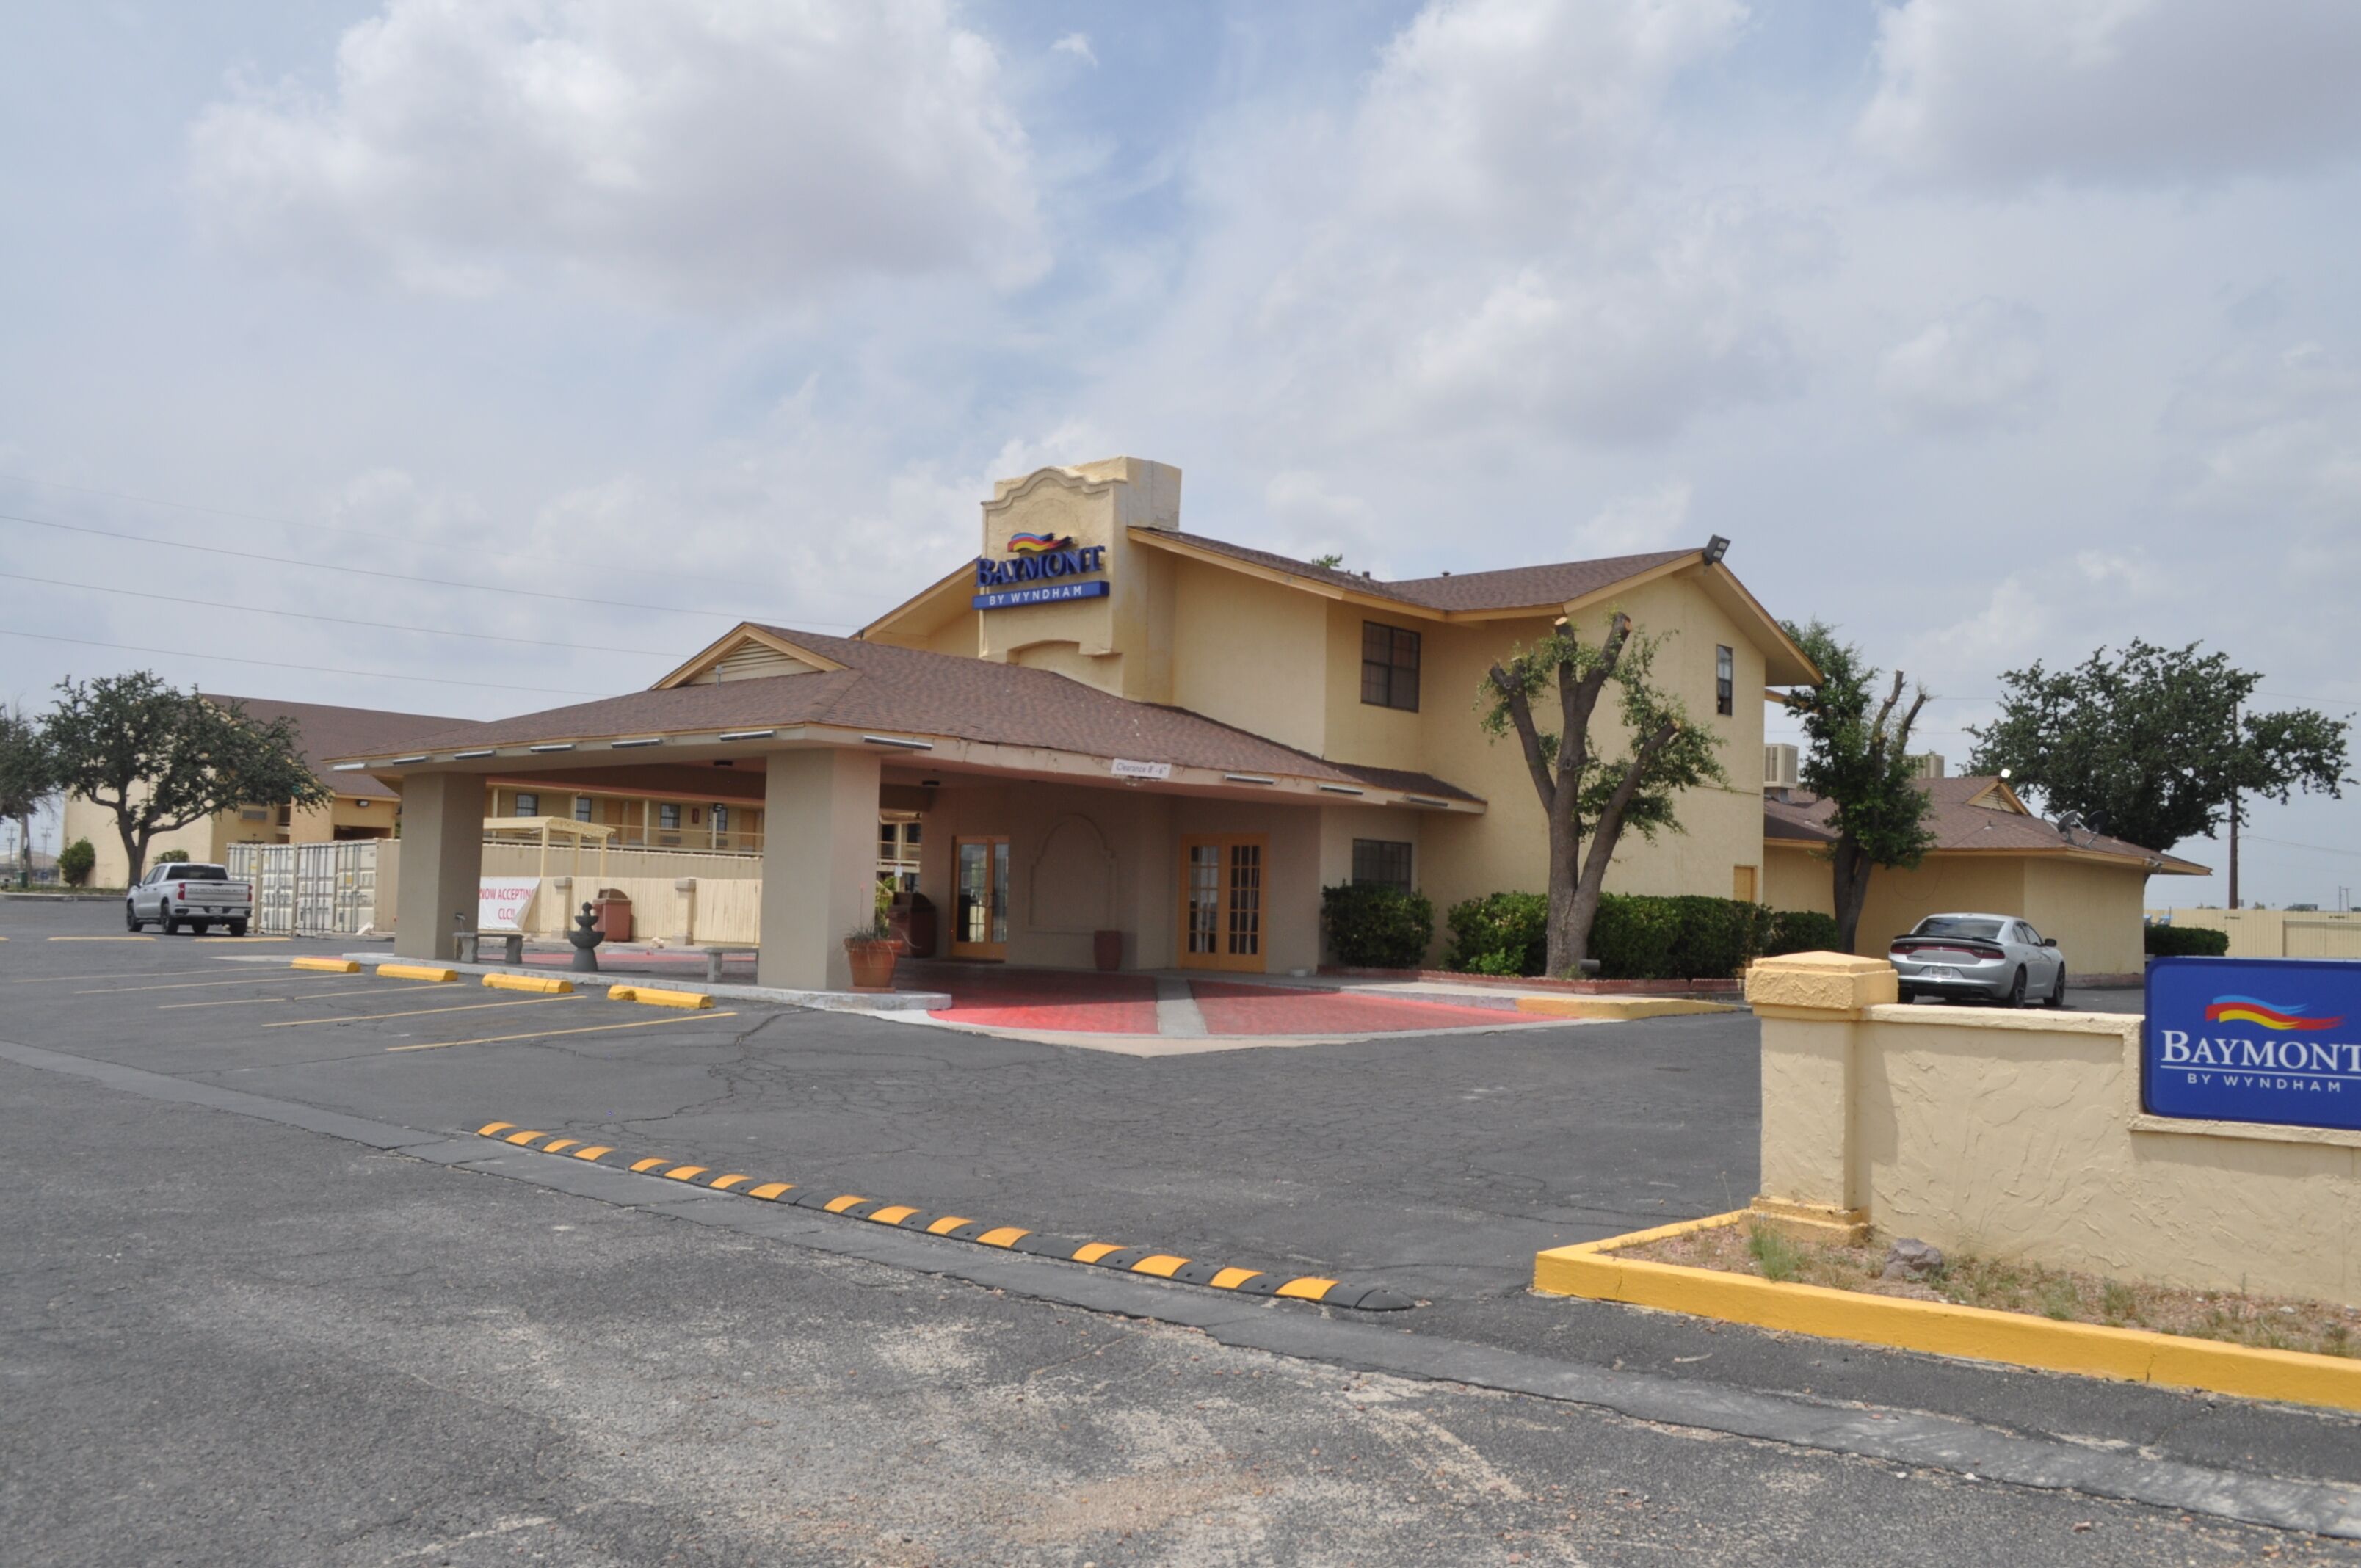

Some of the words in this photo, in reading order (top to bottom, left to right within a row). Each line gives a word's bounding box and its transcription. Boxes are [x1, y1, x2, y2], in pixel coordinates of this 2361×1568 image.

[976, 545, 1105, 587] BAYMONT
[989, 595, 1004, 606] BY
[1011, 585, 1082, 603] WYNDHAM
[2161, 1029, 2361, 1072] BAYMONT
[2187, 1073, 2211, 1085] BY
[2223, 1075, 2341, 1093] WYNDHAM
